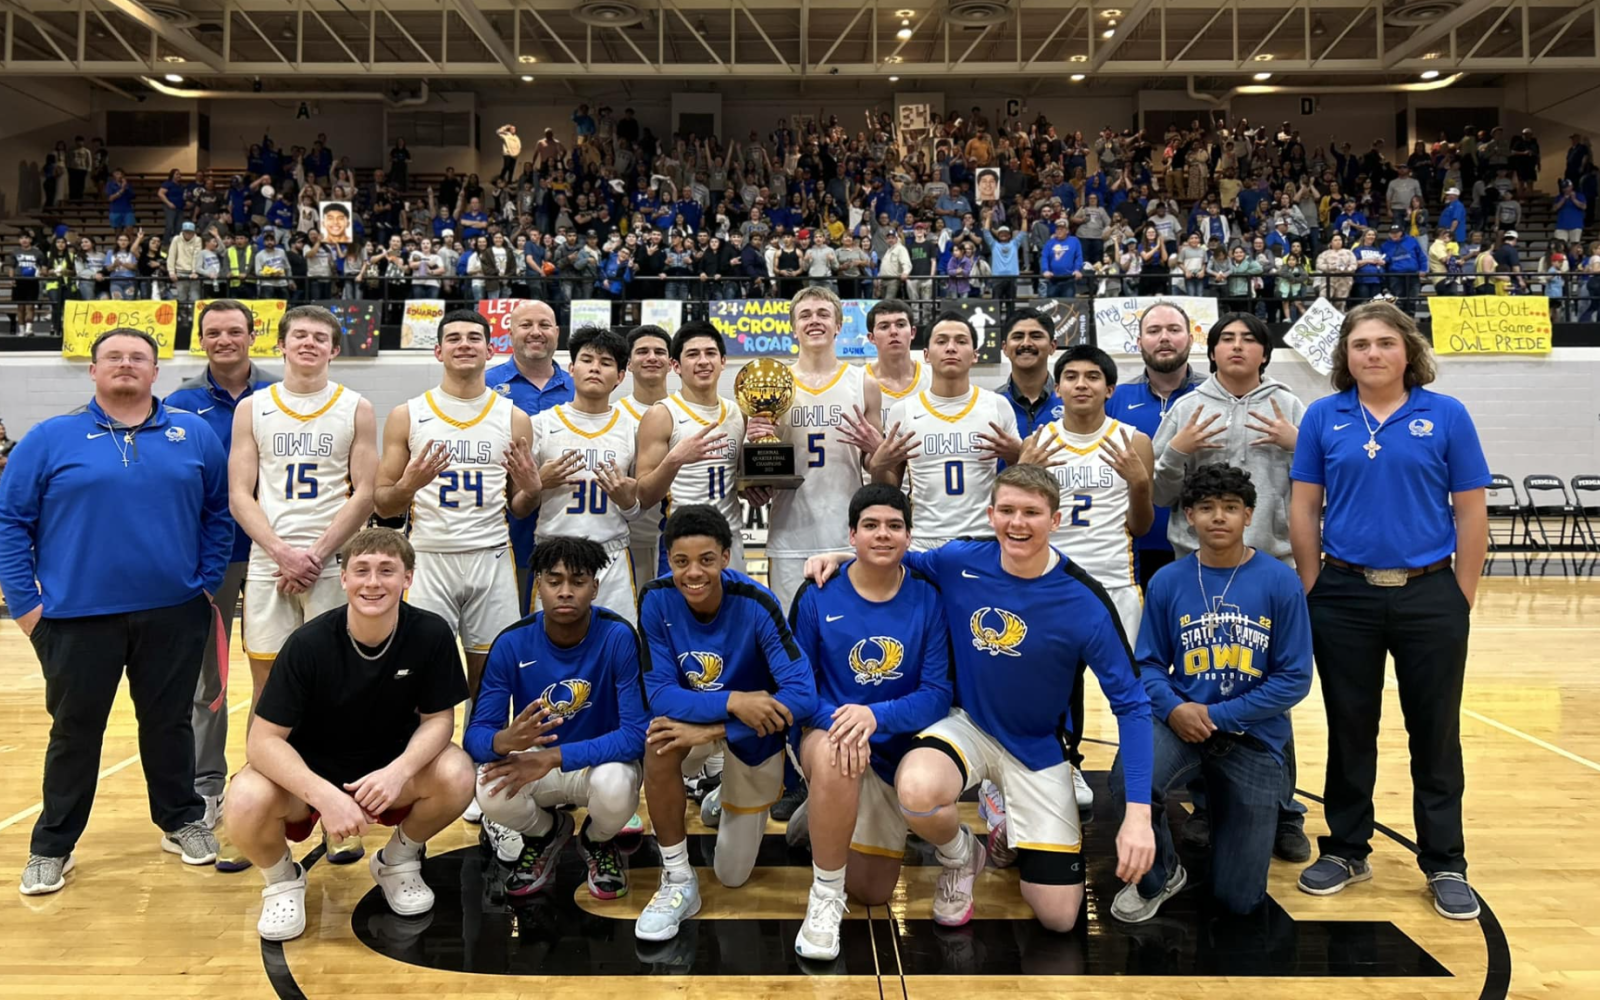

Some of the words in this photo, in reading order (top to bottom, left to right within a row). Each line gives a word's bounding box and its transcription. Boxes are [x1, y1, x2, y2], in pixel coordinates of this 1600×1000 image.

[297, 102, 310, 119] A
[1007, 100, 1019, 117] C
[407, 307, 444, 318] EDUARDO
[717, 302, 738, 316] 24
[743, 300, 790, 316] MAKE
[1124, 299, 1137, 310] all
[1459, 298, 1494, 317] ALL
[737, 316, 793, 334] CROW
[1294, 315, 1326, 343] RC
[1461, 320, 1496, 335] ALL
[1450, 334, 1490, 352] OWL
[1495, 334, 1547, 350] PRIDE
[791, 405, 842, 427] OWLS
[273, 433, 333, 456] OWLS
[432, 440, 491, 465] OWLS
[807, 433, 825, 468] 5
[924, 432, 982, 456] OWLS
[285, 463, 318, 500] 15
[708, 466, 725, 499] 11
[945, 460, 964, 496] 0
[1055, 466, 1113, 489] OWLS
[439, 470, 483, 509] 24
[566, 479, 608, 514] 30
[1071, 494, 1093, 527] 2
[1259, 615, 1272, 629] 22
[1235, 624, 1270, 649] PLAYOFFS
[1183, 643, 1263, 678] OWL
